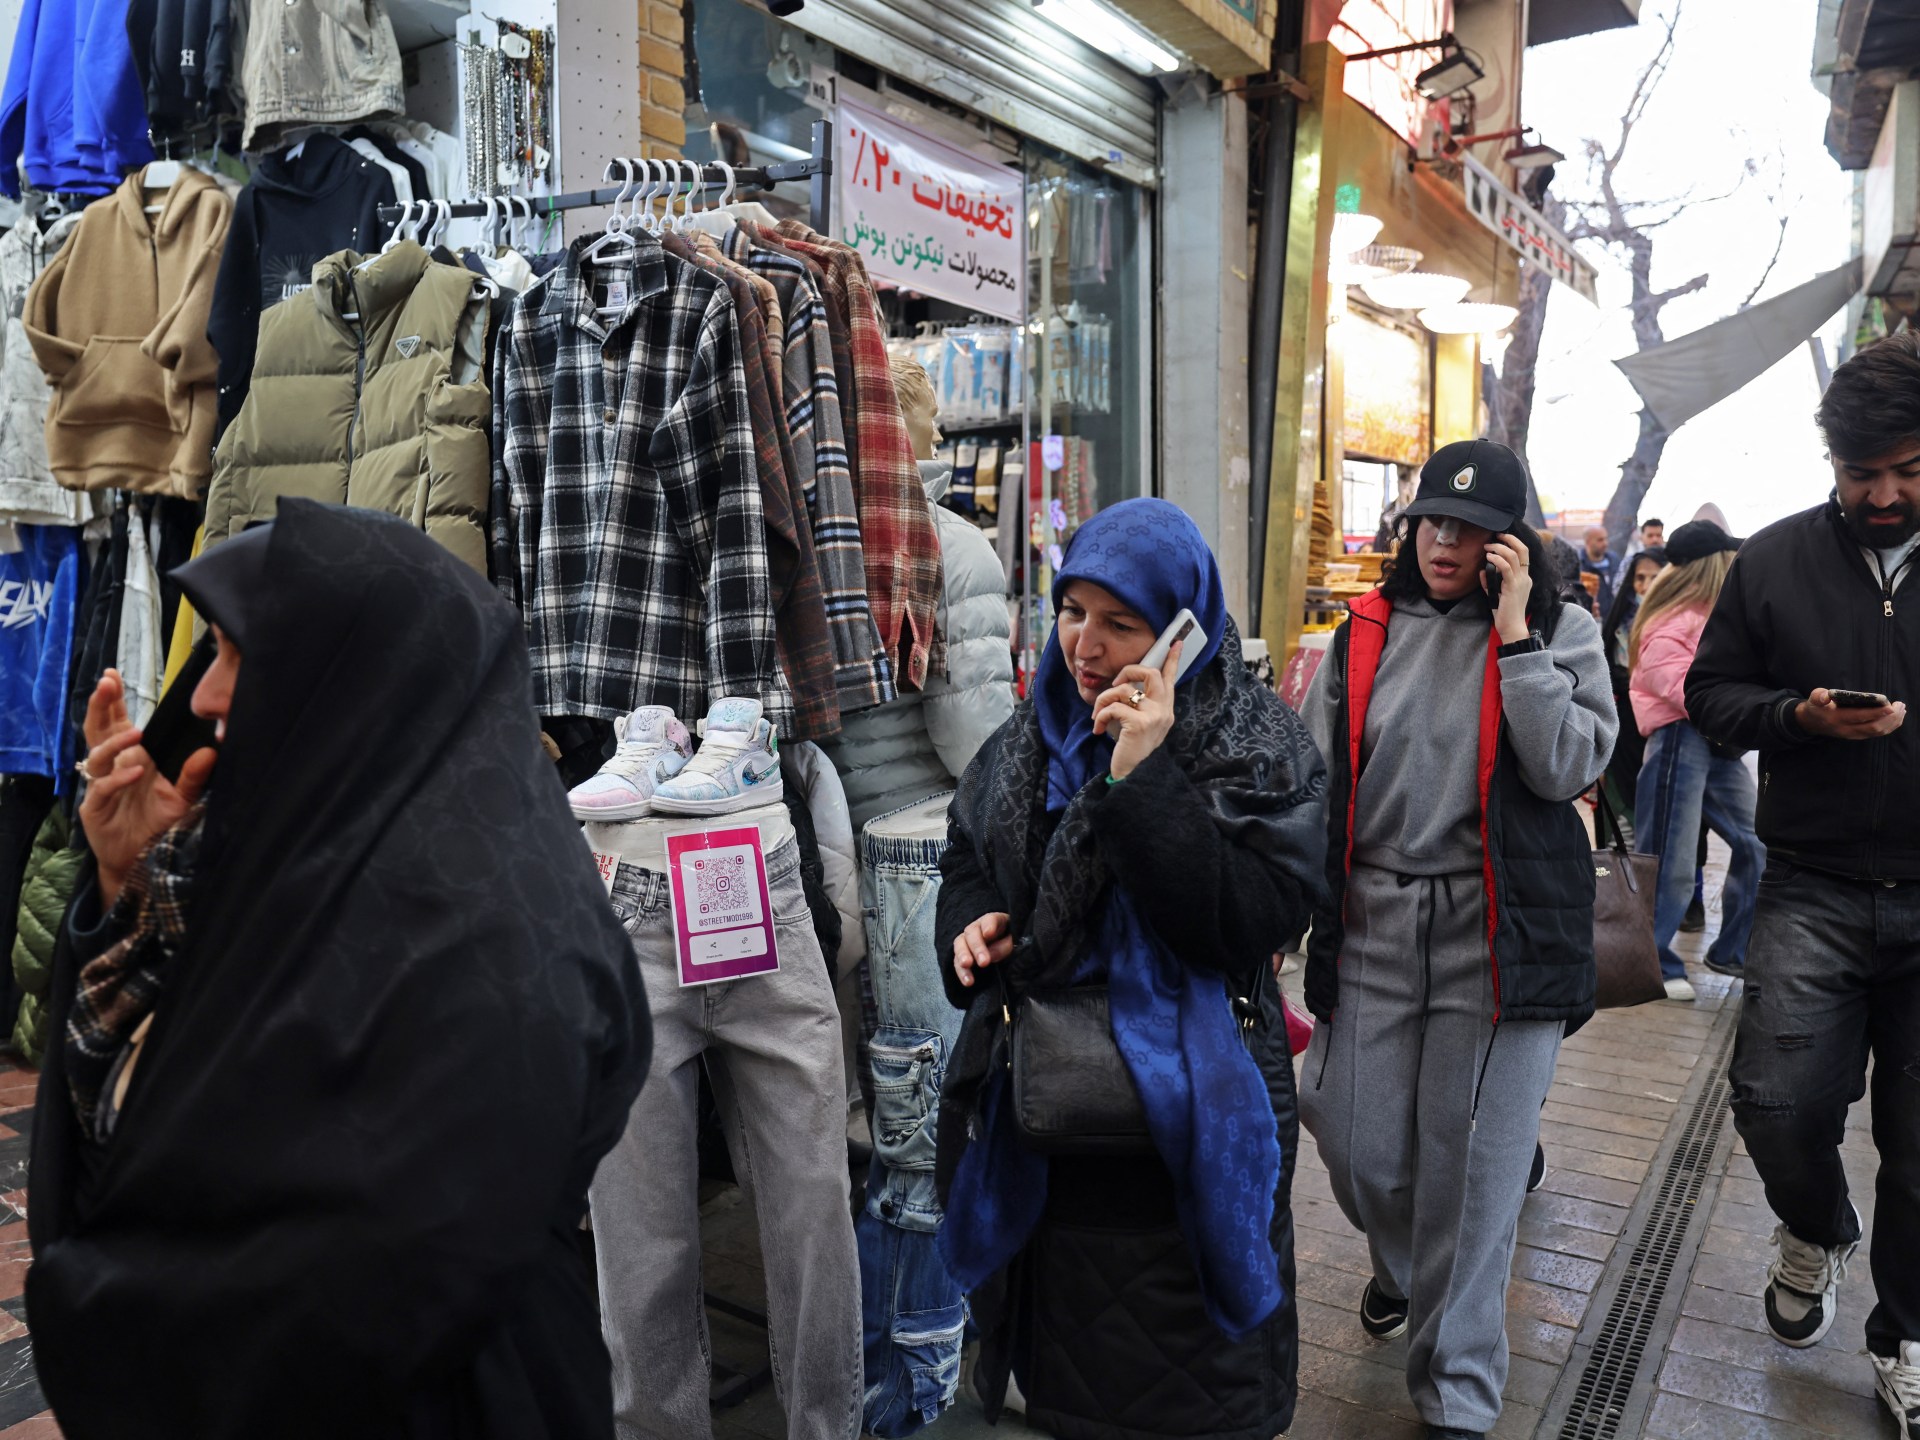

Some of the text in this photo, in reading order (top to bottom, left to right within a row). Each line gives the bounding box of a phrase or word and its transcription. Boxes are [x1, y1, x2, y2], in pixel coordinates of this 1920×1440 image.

[180, 49, 196, 66] H
[912, 176, 1013, 239] تخفیفات
[843, 210, 1016, 291] محصولات نیکوتن پوش
